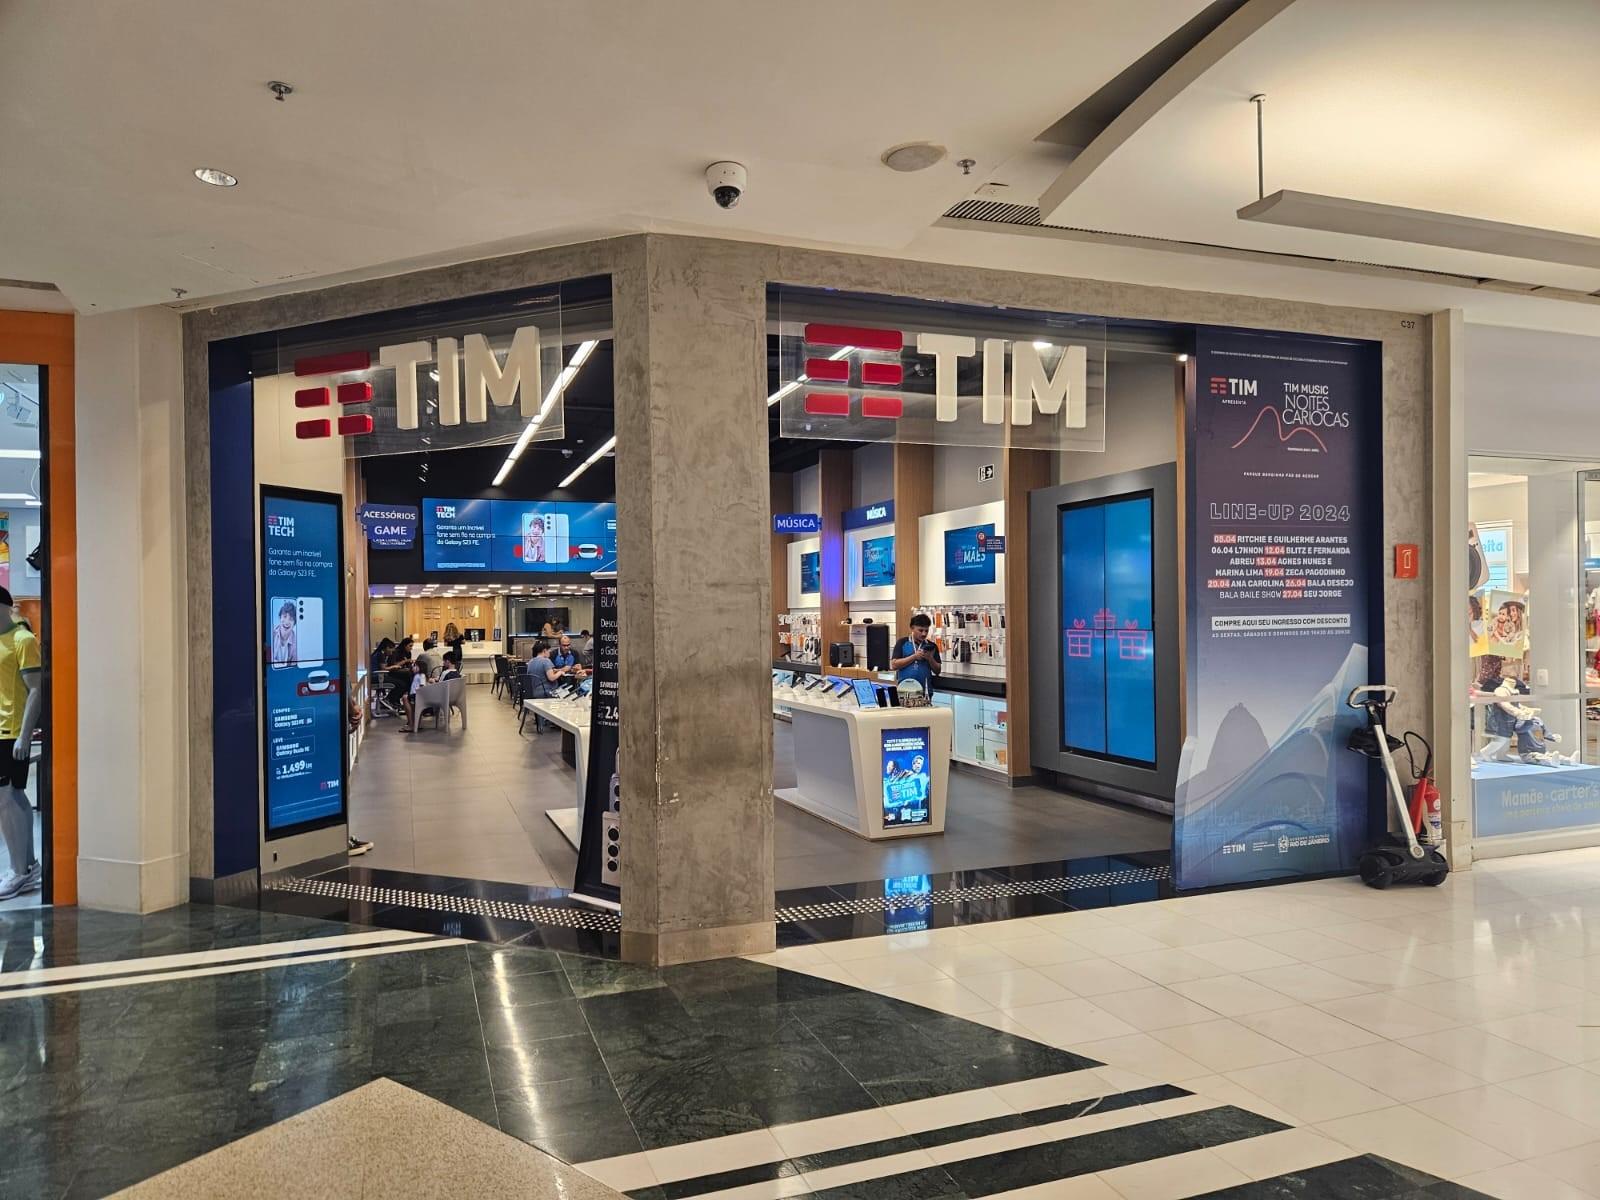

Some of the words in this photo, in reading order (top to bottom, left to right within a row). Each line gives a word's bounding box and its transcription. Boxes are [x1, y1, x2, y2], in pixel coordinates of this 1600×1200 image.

[1400, 320, 1416, 329] C37
[379, 326, 541, 430] TIM
[917, 333, 1087, 428] TIM
[1228, 378, 1258, 396] TIM
[1283, 382, 1299, 393] TIM
[1301, 384, 1329, 395] MUSIC
[1285, 394, 1330, 411] NOITES
[1282, 409, 1350, 428] CARIOCAS
[363, 510, 416, 520] ACESSÓRIOS
[866, 507, 886, 520] MÚSICA
[1210, 502, 1295, 520] LINE-UP
[1299, 504, 1351, 521] 2024
[278, 516, 294, 527] TIM
[777, 516, 815, 528] MÚSICA
[268, 525, 295, 537] TECH
[374, 526, 407, 535] GAME
[1214, 535, 1236, 543] 05.04
[1237, 535, 1266, 543] RITCHIE
[268, 547, 291, 556] Garanta
[1211, 546, 1233, 554] 06.04
[268, 557, 281, 566] fone
[295, 558, 304, 567] fio
[304, 559, 312, 567] na
[312, 560, 333, 568] compra
[277, 569, 297, 578] Galaxy
[297, 569, 307, 577] S23
[1264, 568, 1284, 576] 19.04
[1207, 580, 1230, 588] 20.04
[1247, 580, 1284, 588] CAROLINA
[1326, 579, 1354, 587] DESEJO
[1219, 591, 1238, 599] BALA
[1240, 591, 1260, 599] BAILE
[1261, 591, 1282, 599] SHOW
[1282, 590, 1302, 598] 27.04
[1303, 590, 1318, 598] SEU
[600, 660, 613, 669] rede
[282, 760, 306, 774] 1.499
[327, 779, 339, 789] TIM
[1502, 787, 1543, 808] Mamãe
[1231, 844, 1246, 853] TIM
